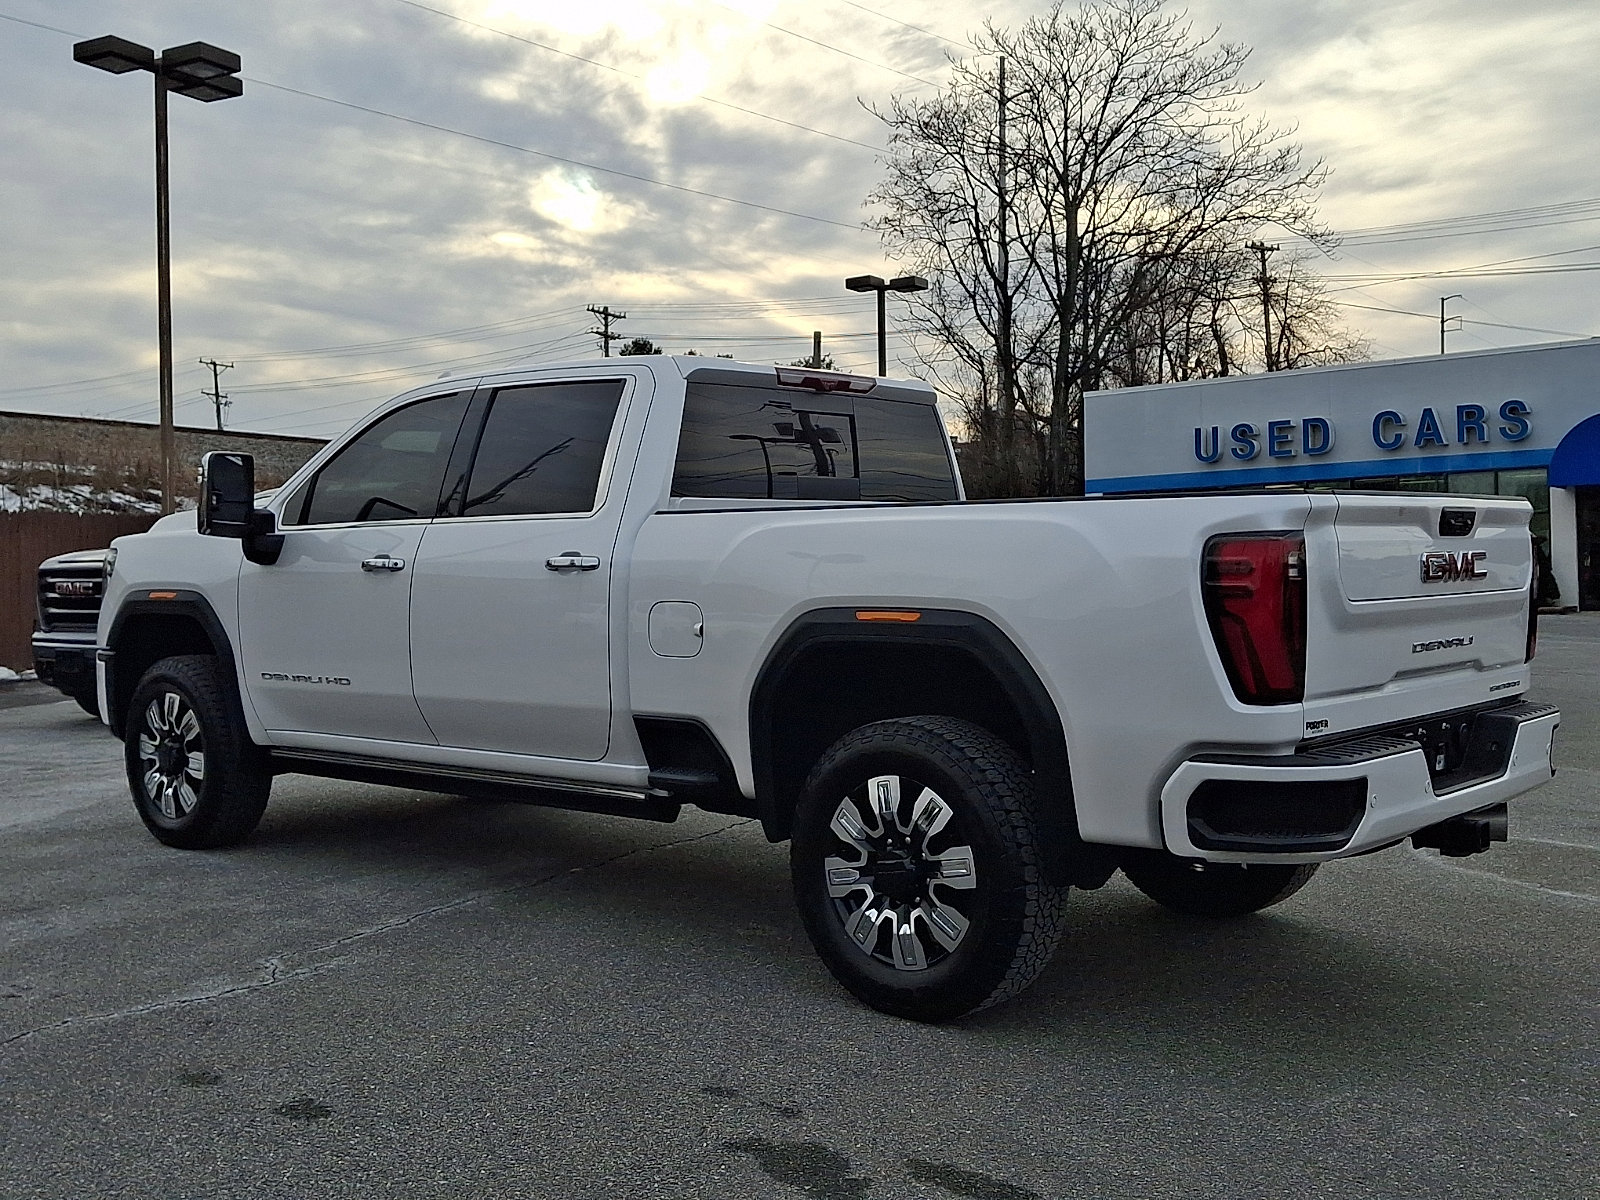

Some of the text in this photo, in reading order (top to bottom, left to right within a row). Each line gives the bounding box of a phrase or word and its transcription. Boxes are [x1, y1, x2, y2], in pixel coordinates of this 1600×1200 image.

[1193, 399, 1533, 464] USED CARS
[1420, 551, 1488, 584] GMC
[55, 582, 94, 595] GMC
[1411, 635, 1474, 654] DENALI
[260, 672, 351, 686] DENALI HD
